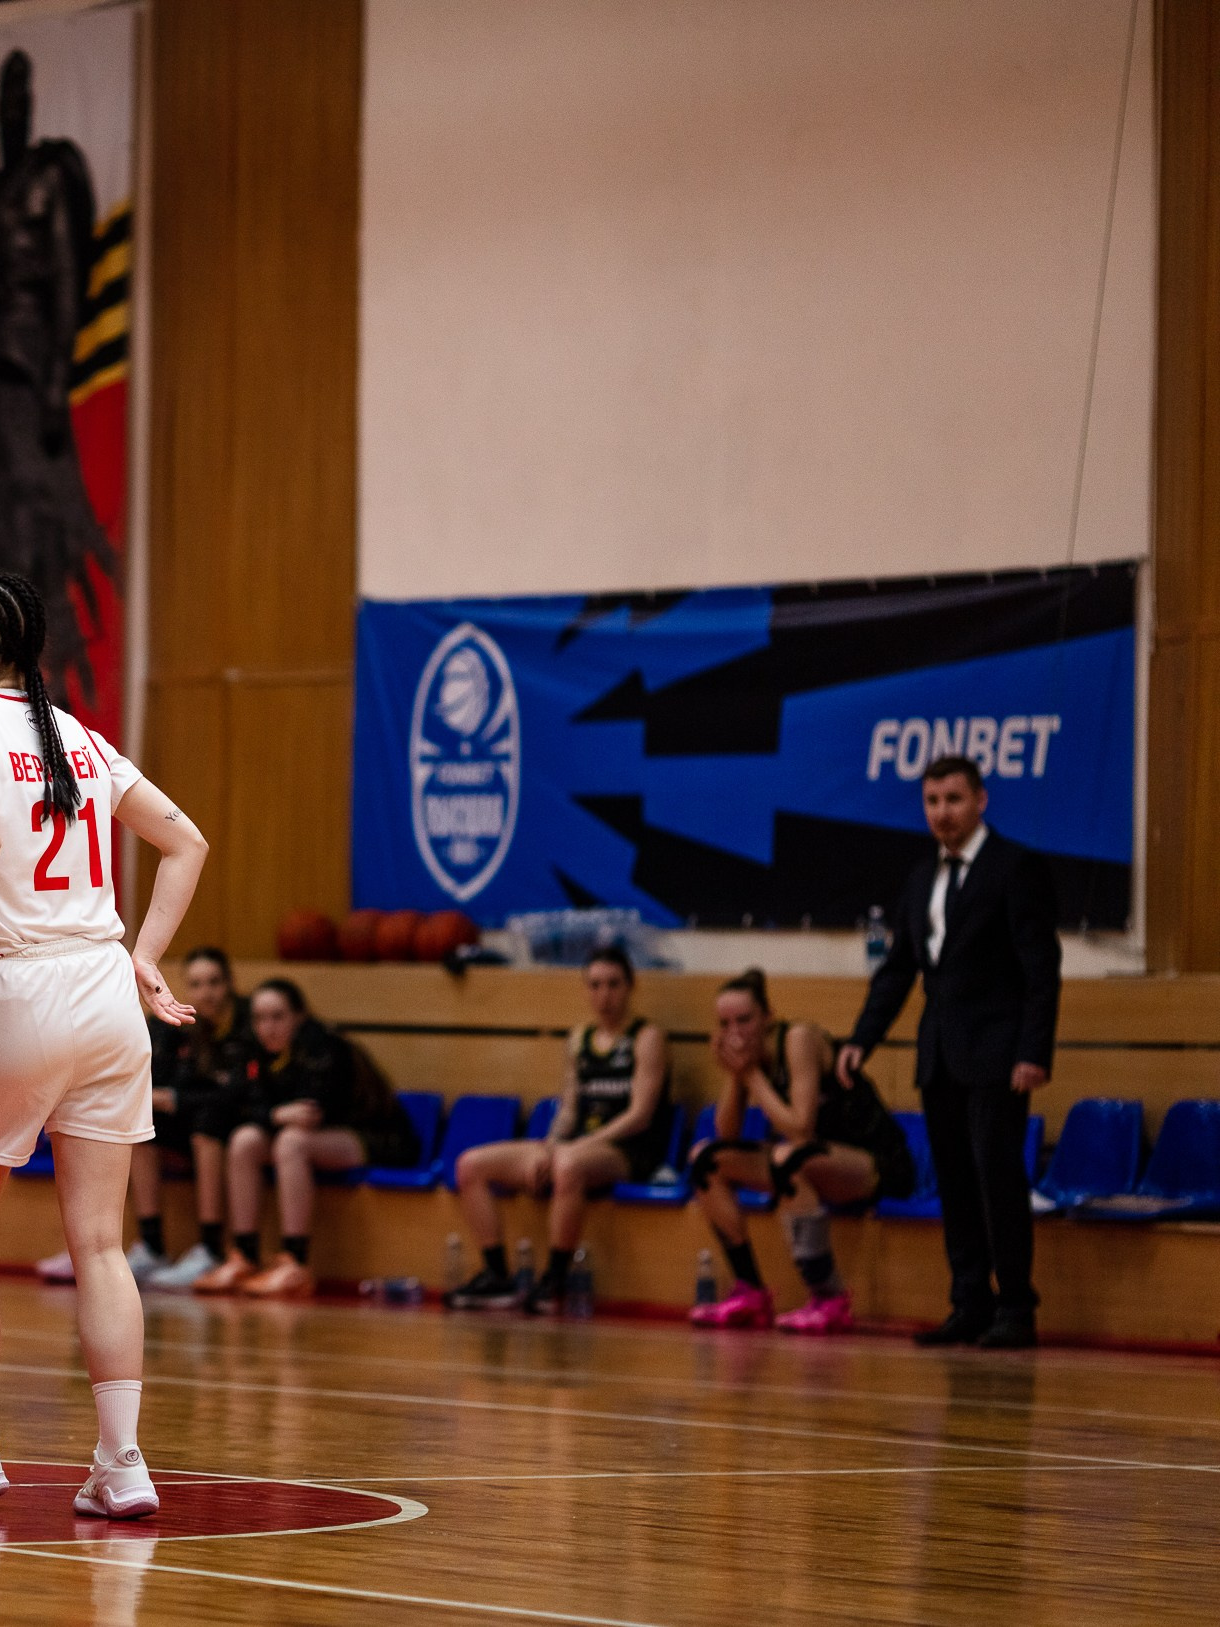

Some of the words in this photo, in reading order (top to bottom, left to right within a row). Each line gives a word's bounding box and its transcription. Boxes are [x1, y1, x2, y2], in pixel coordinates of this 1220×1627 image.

[8, 745, 99, 782] ВЕРЕЙ
[866, 714, 1062, 781] FONBET
[31, 797, 104, 892] 21
